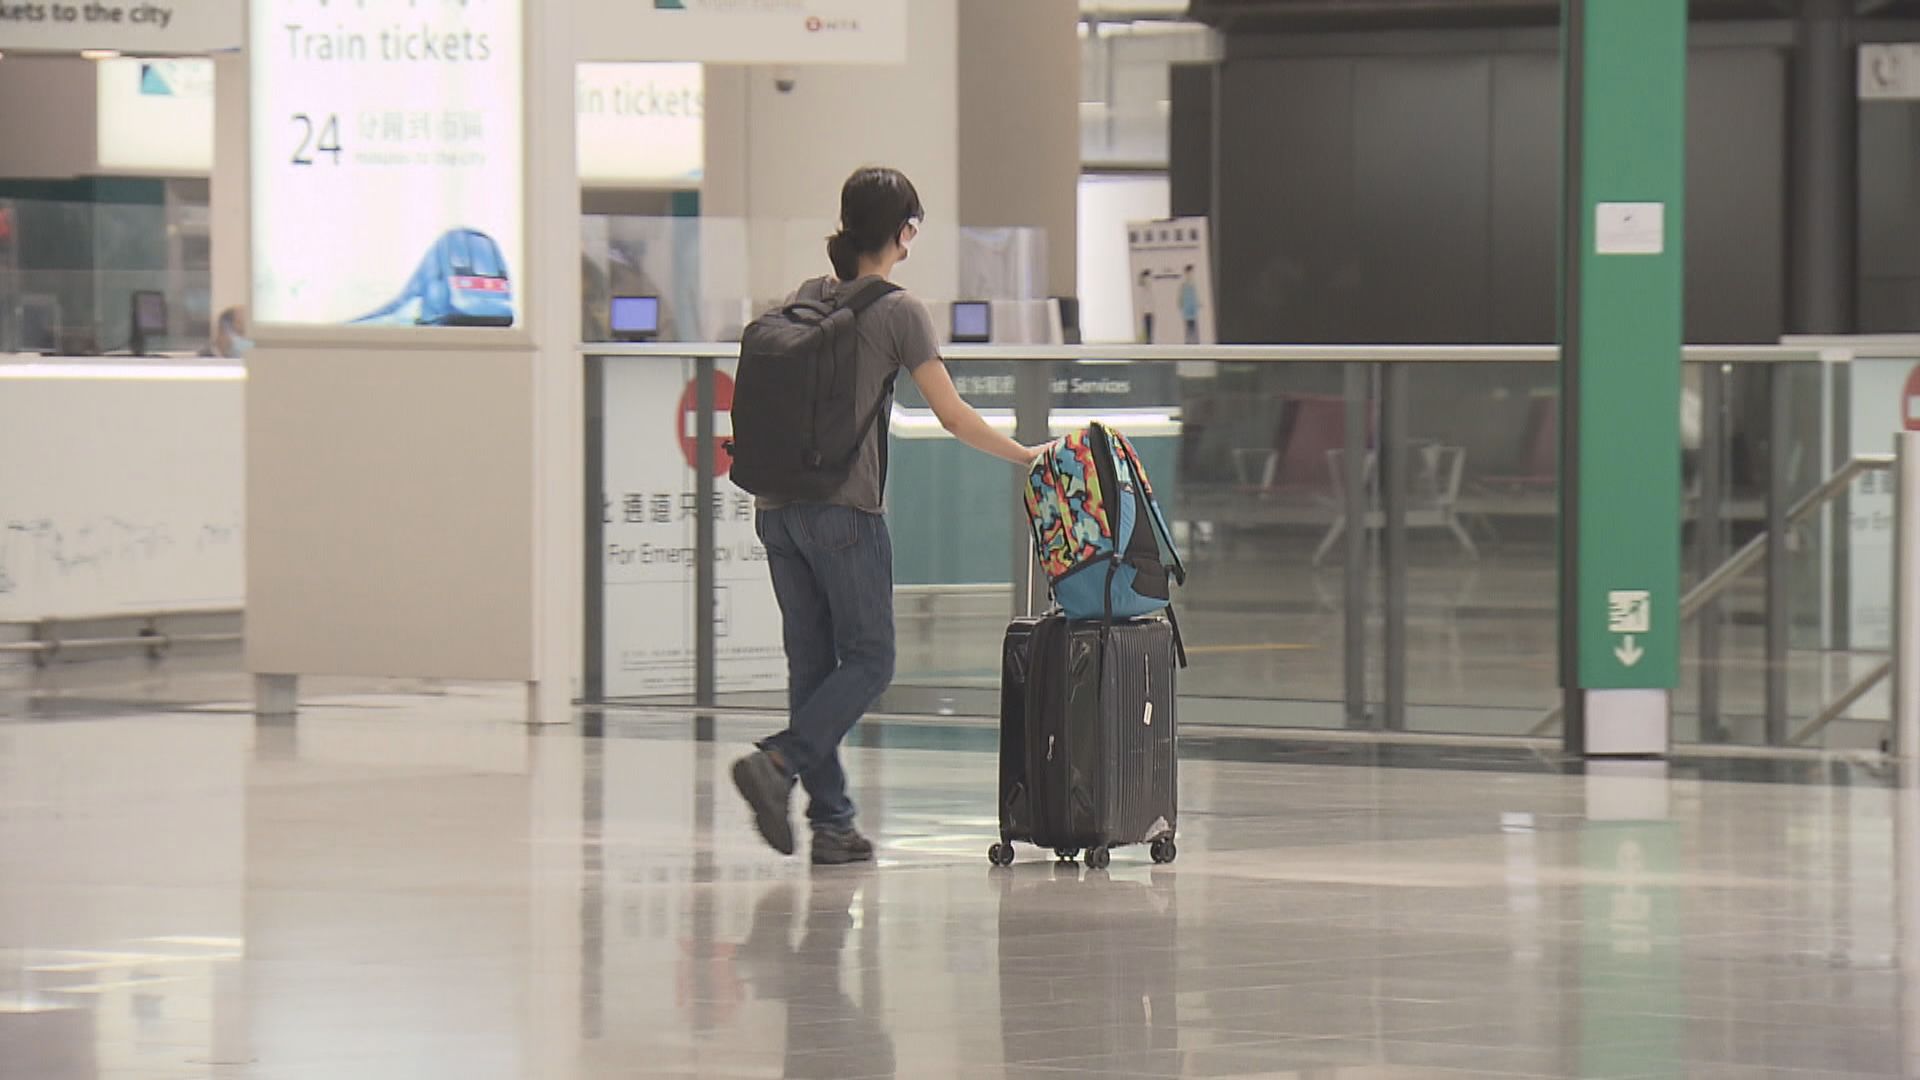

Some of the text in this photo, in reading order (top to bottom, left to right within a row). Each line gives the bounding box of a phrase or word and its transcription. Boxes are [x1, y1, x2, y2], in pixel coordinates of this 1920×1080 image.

[52, 4, 77, 21] to
[84, 4, 122, 22] the
[130, 5, 173, 29] city
[285, 23, 491, 62] Train tickets
[290, 112, 343, 166] 24
[1071, 376, 1131, 394] Services
[609, 543, 635, 565] For
[641, 542, 732, 567] Emergcy
